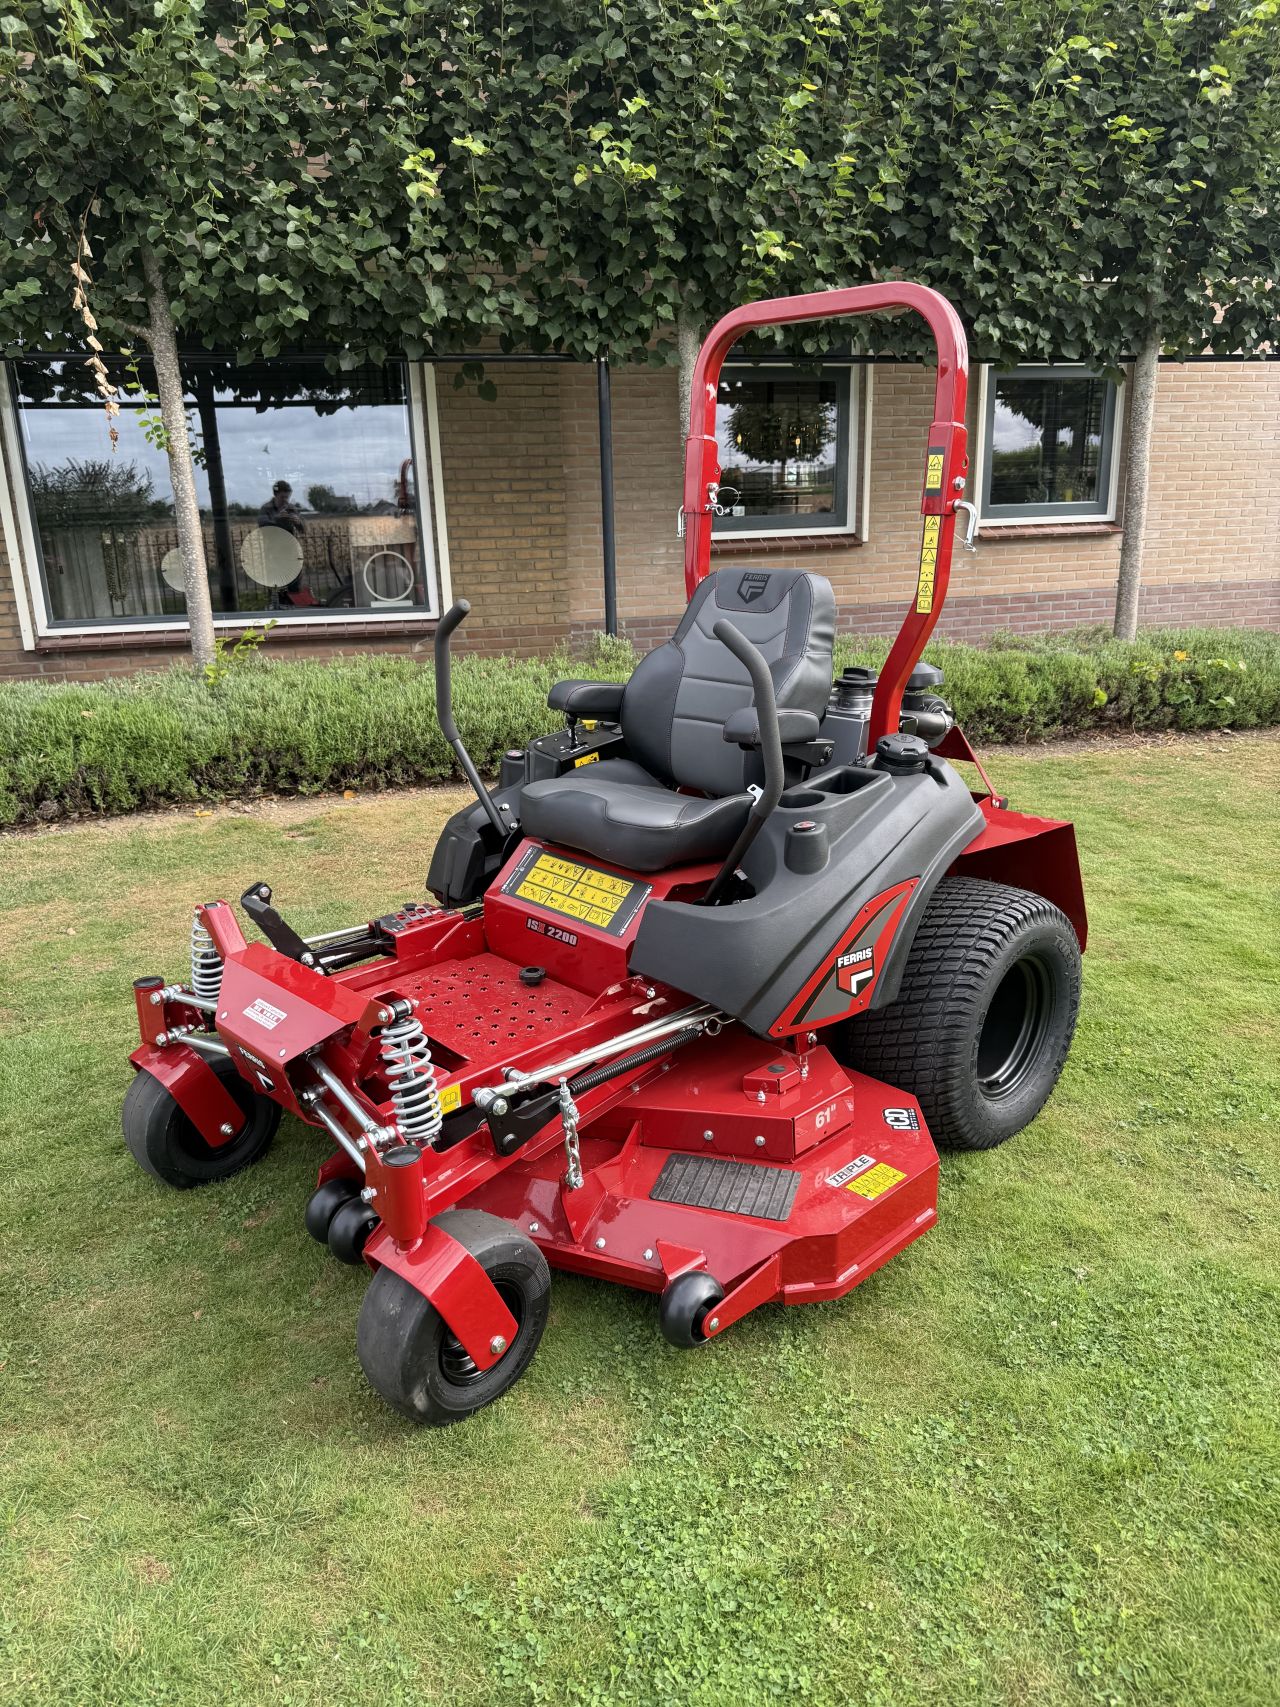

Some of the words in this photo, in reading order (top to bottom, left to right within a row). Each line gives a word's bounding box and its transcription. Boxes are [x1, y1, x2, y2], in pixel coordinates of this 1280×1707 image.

[744, 573, 769, 581] FERRIS
[527, 918, 546, 934] ISX
[547, 926, 578, 946] 2200
[837, 947, 873, 968] FERRIS
[829, 1156, 870, 1183] TRIPLE
